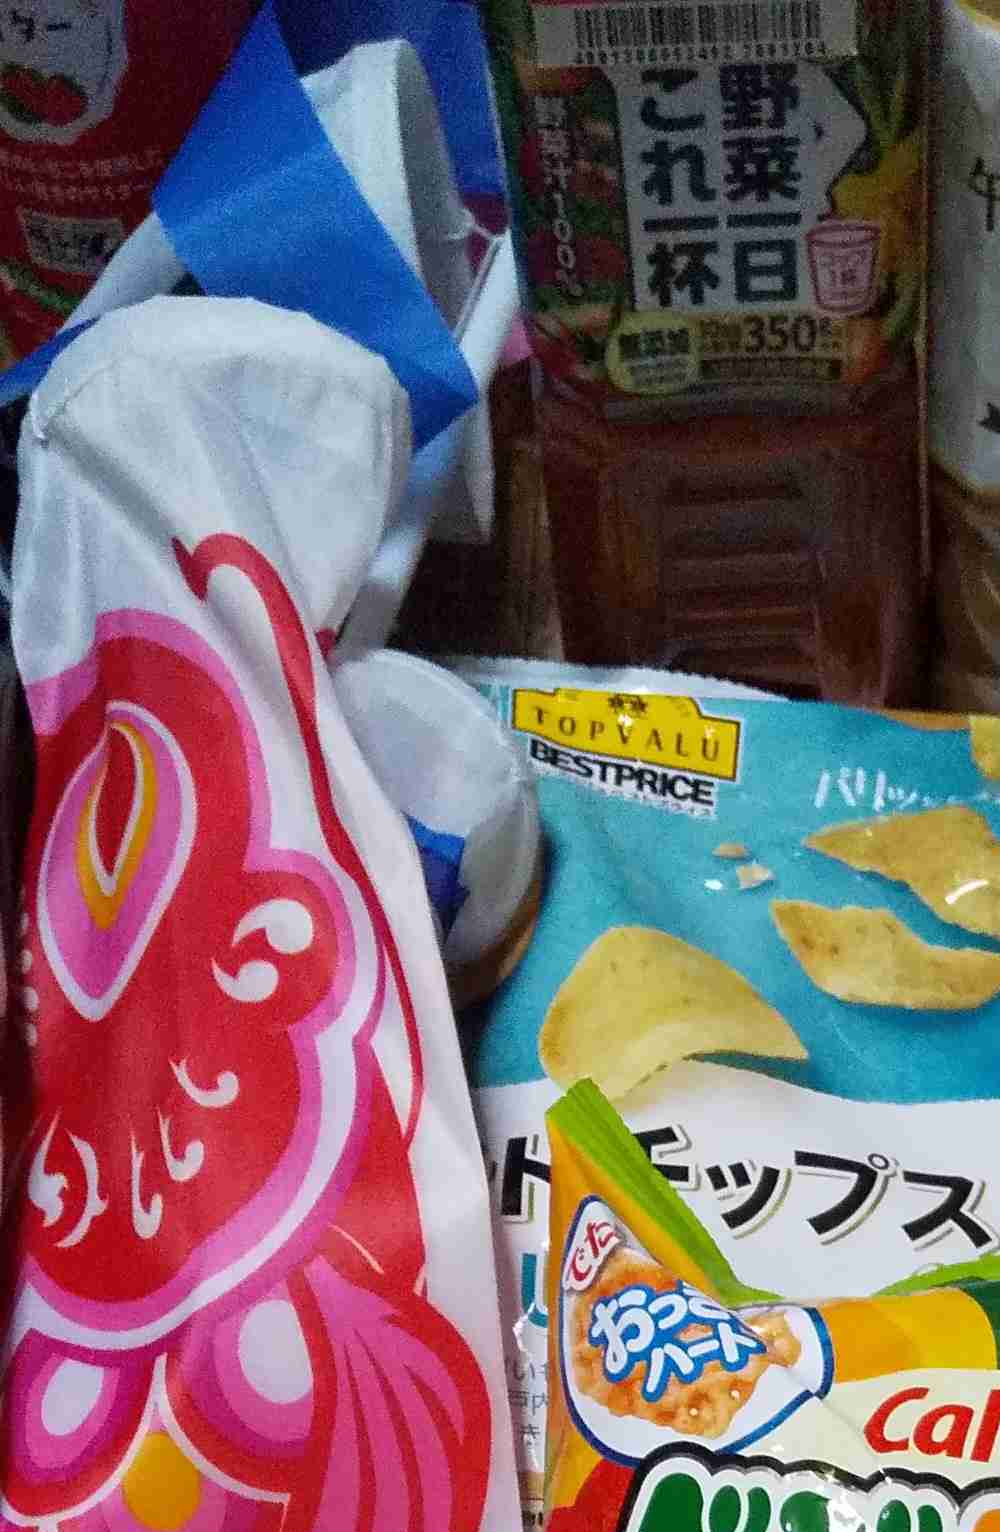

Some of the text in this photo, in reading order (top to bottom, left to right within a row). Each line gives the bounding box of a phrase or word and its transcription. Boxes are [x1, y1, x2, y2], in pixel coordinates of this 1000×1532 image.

[640, 68, 720, 307] これ一杯
[532, 704, 720, 762] TOPVALU
